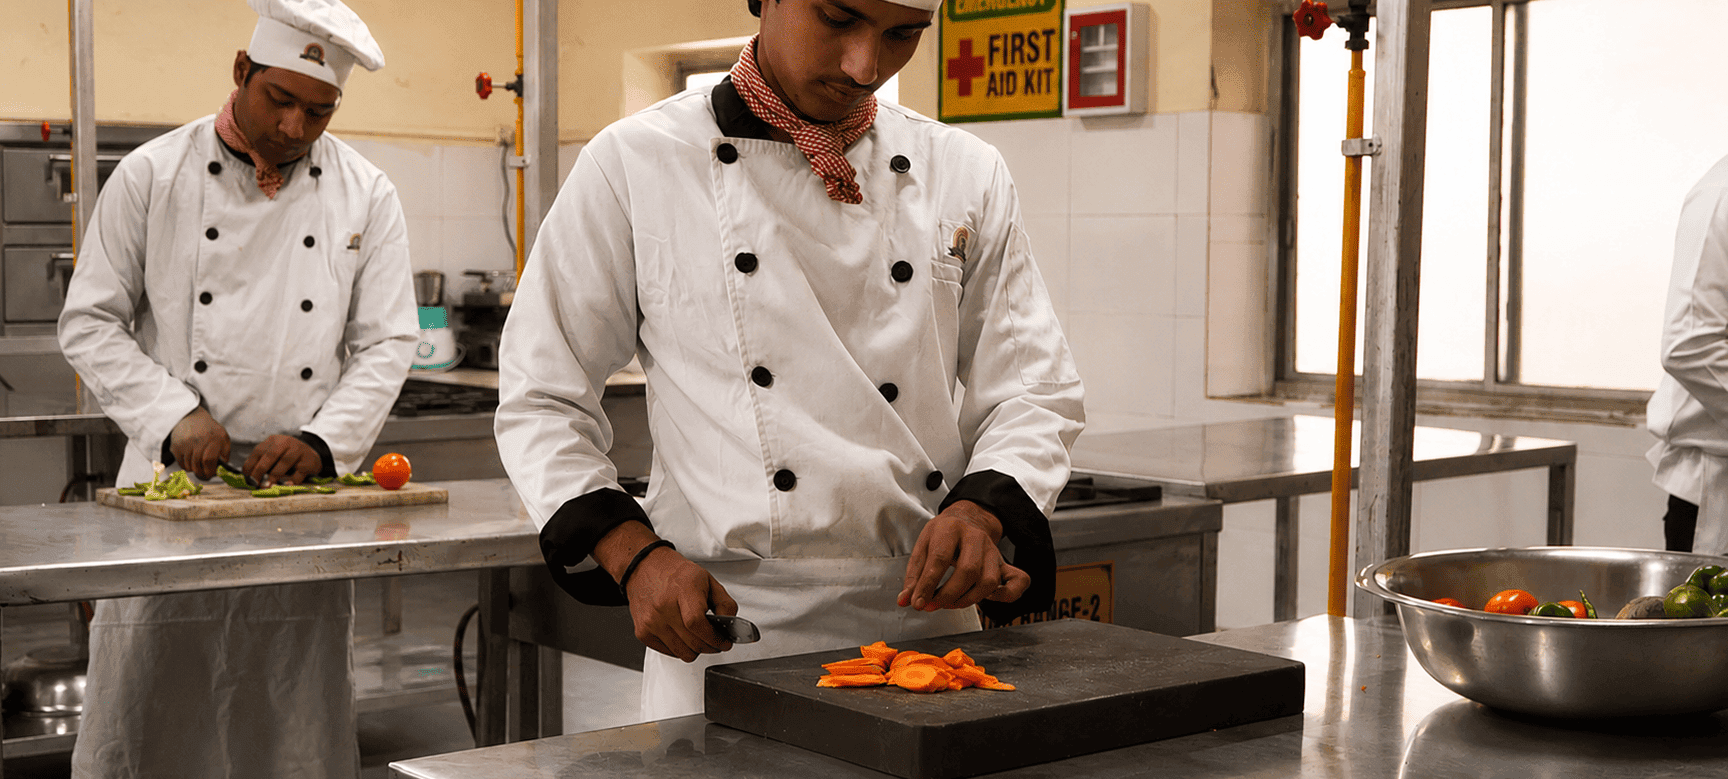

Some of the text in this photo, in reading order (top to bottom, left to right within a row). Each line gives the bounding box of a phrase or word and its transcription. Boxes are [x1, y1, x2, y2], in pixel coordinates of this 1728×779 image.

[988, 28, 1056, 66] FIRST
[986, 68, 1055, 98] AID KIT
